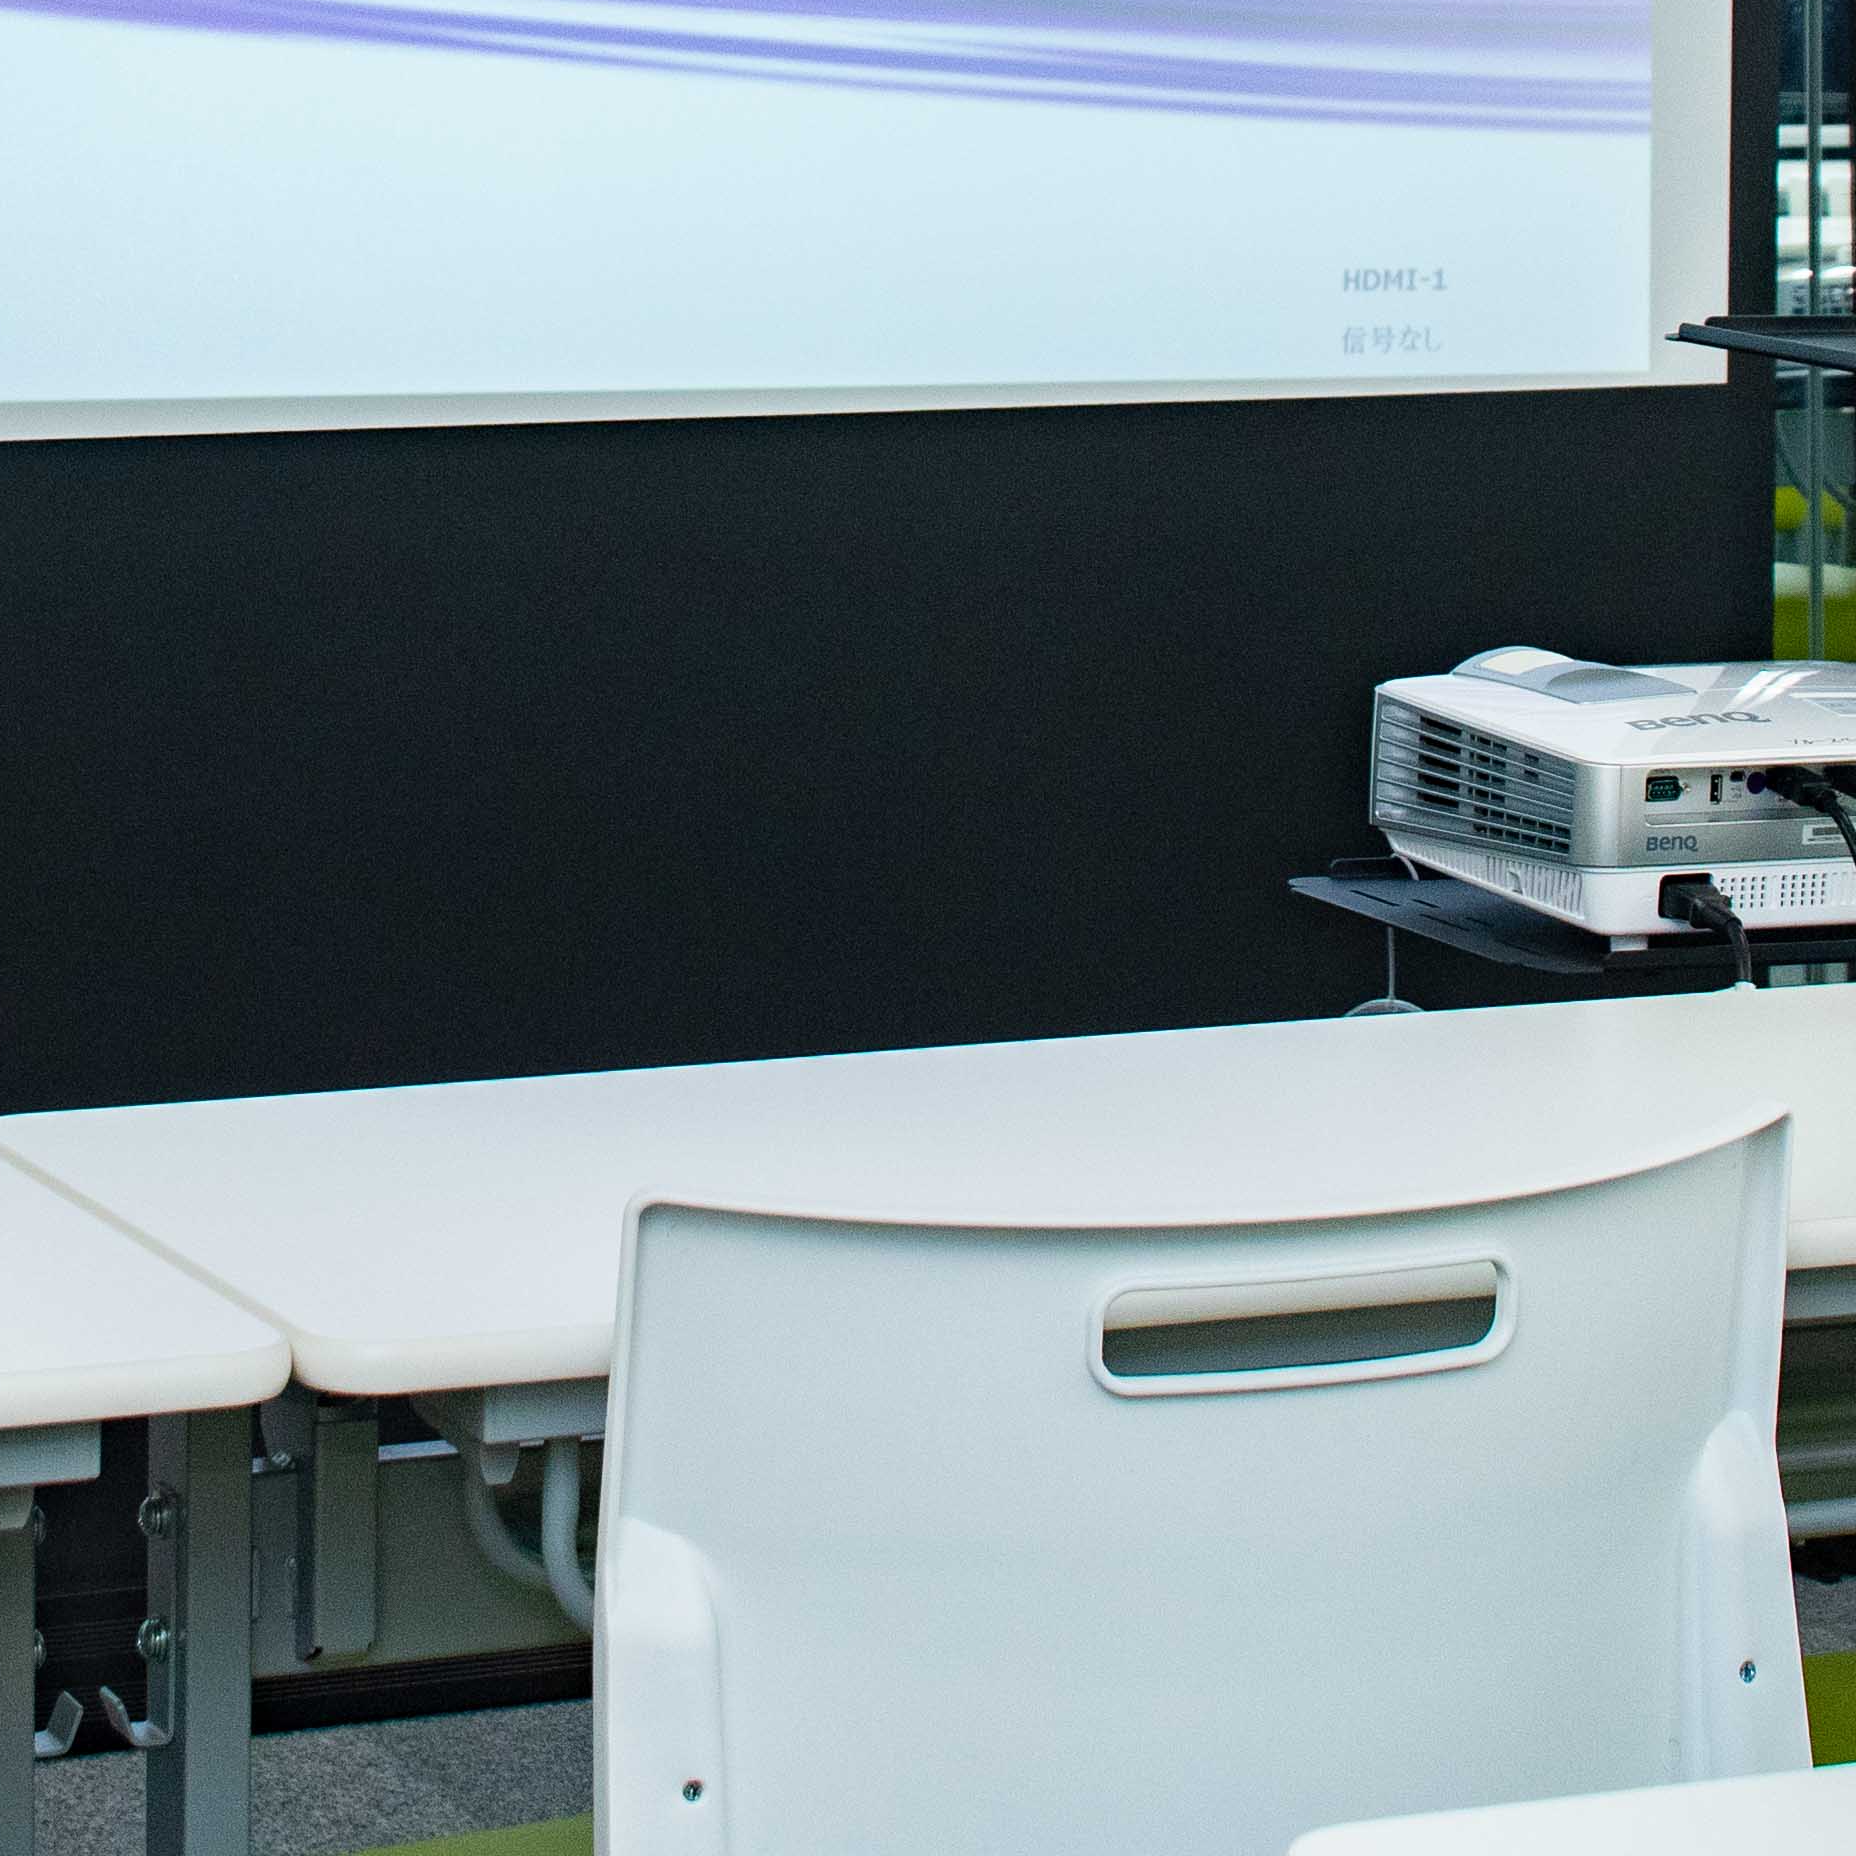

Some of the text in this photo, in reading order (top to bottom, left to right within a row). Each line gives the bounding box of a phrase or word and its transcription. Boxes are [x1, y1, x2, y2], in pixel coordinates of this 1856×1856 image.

[1343, 268, 1448, 292] HDMI-1
[1341, 325, 1442, 355] 信号なし
[1627, 710, 1772, 732] BenQ
[1646, 835, 1698, 852] BenQ
